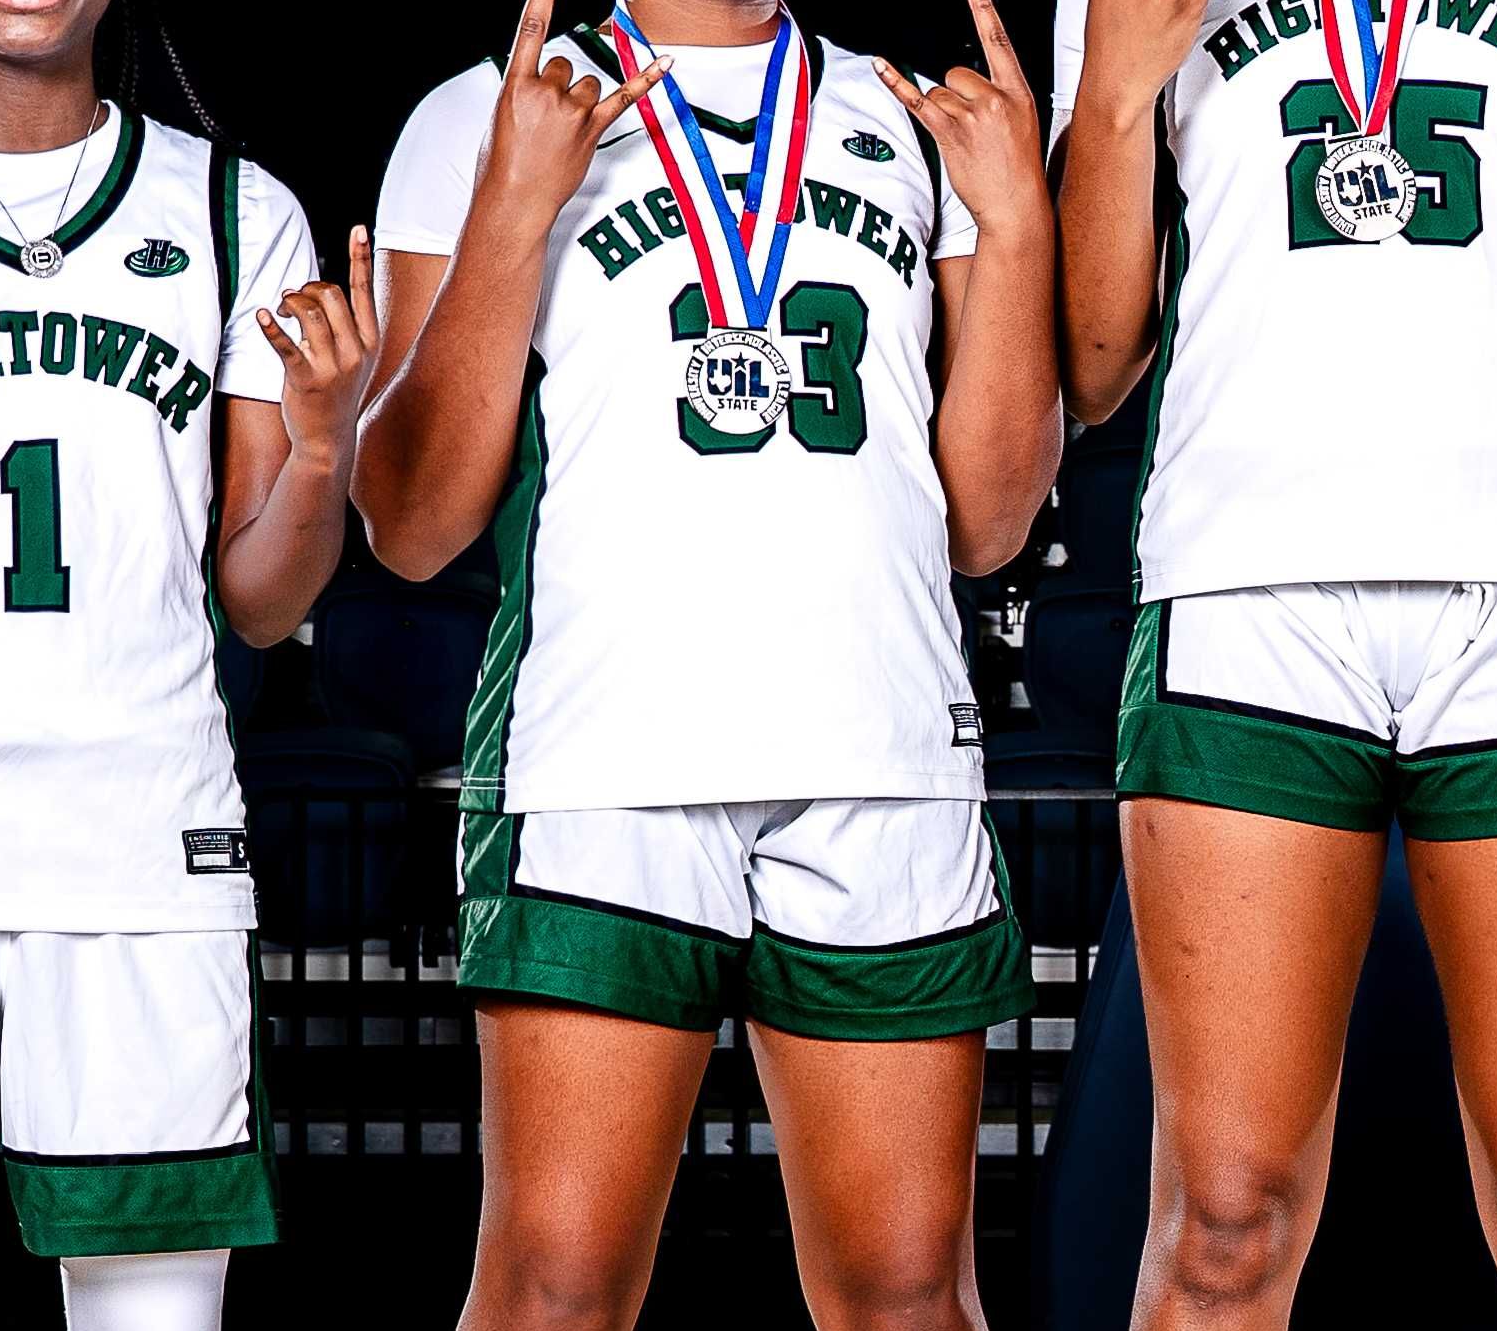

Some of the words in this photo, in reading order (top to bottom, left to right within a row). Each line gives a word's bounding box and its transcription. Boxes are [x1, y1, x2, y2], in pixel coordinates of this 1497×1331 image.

[1279, 78, 1488, 251] 25
[1353, 203, 1392, 220] STATE
[577, 173, 917, 289] HIGWER
[717, 398, 758, 410] STATE
[0, 438, 70, 613] 1
